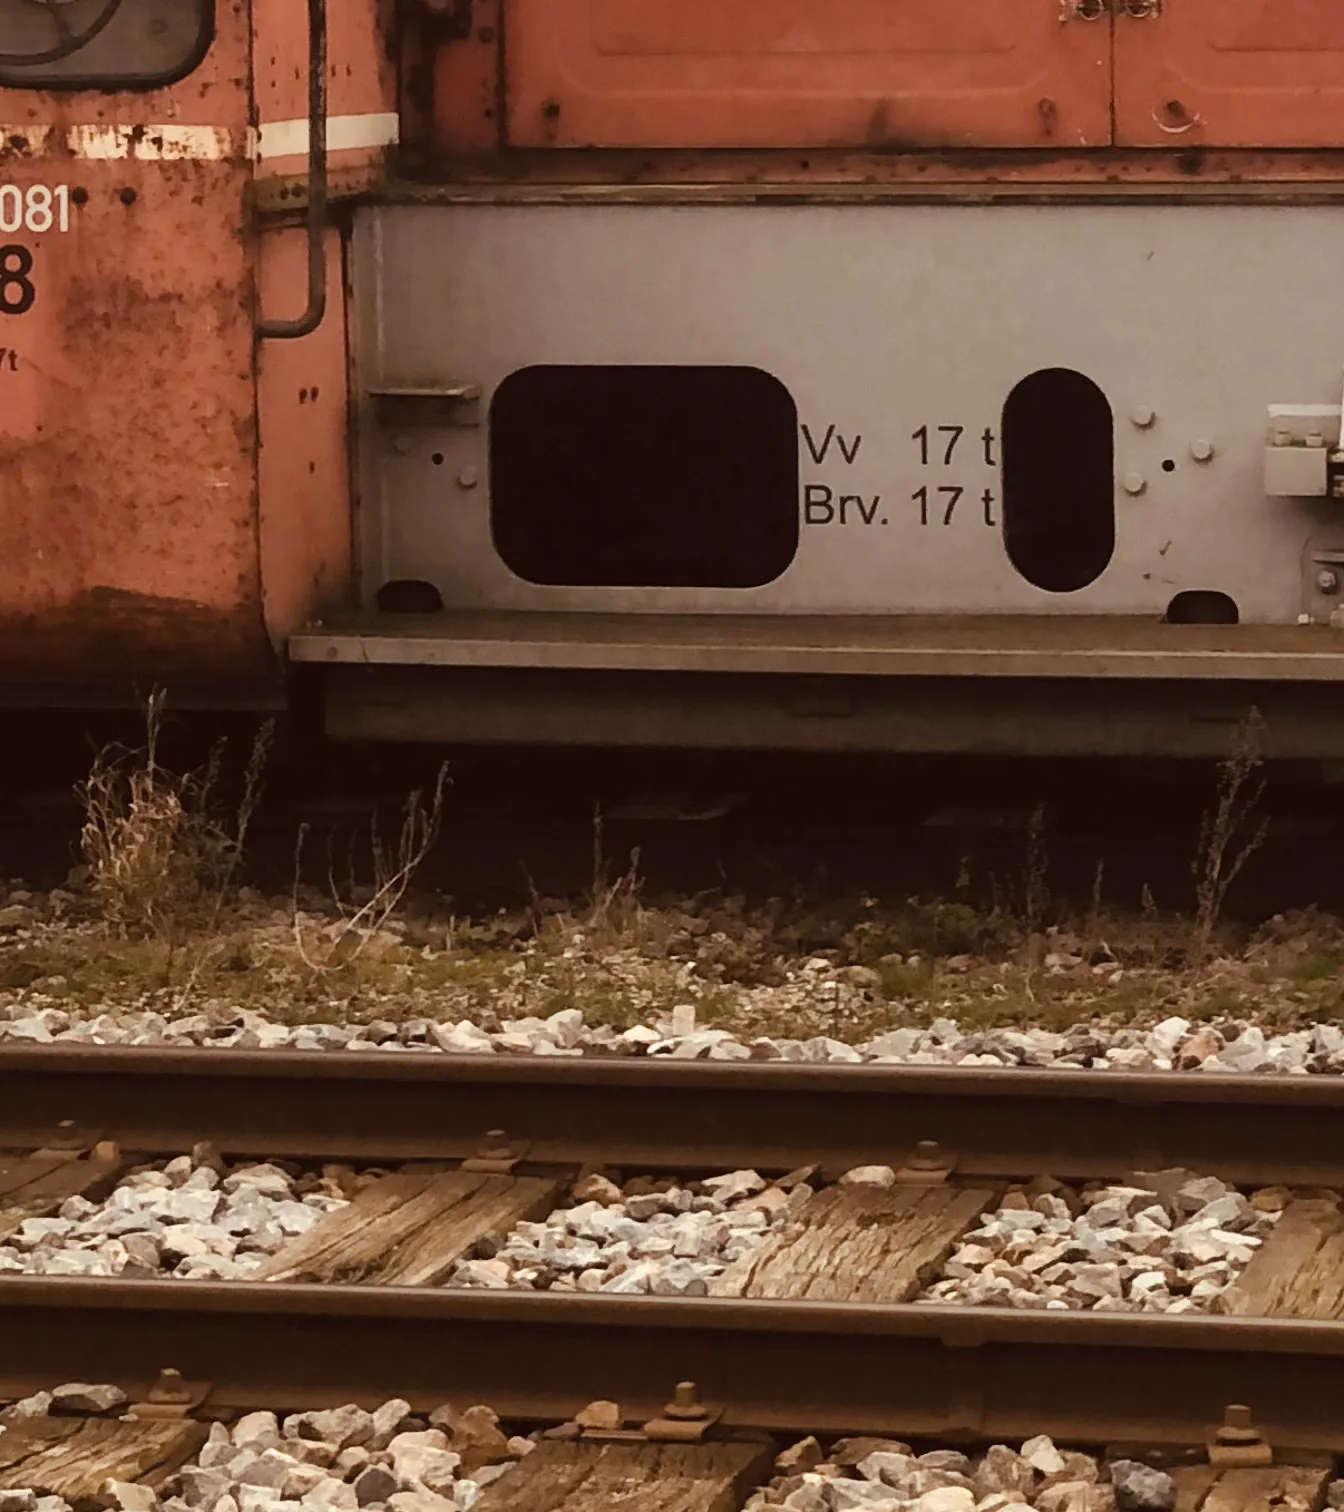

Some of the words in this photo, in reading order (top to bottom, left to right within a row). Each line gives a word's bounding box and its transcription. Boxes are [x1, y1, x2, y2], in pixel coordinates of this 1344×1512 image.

[800, 424, 862, 465] Vv
[911, 424, 964, 466] 17
[981, 427, 997, 466] t
[804, 485, 888, 525] Brv.
[911, 486, 964, 526] 17
[981, 489, 997, 526] t
